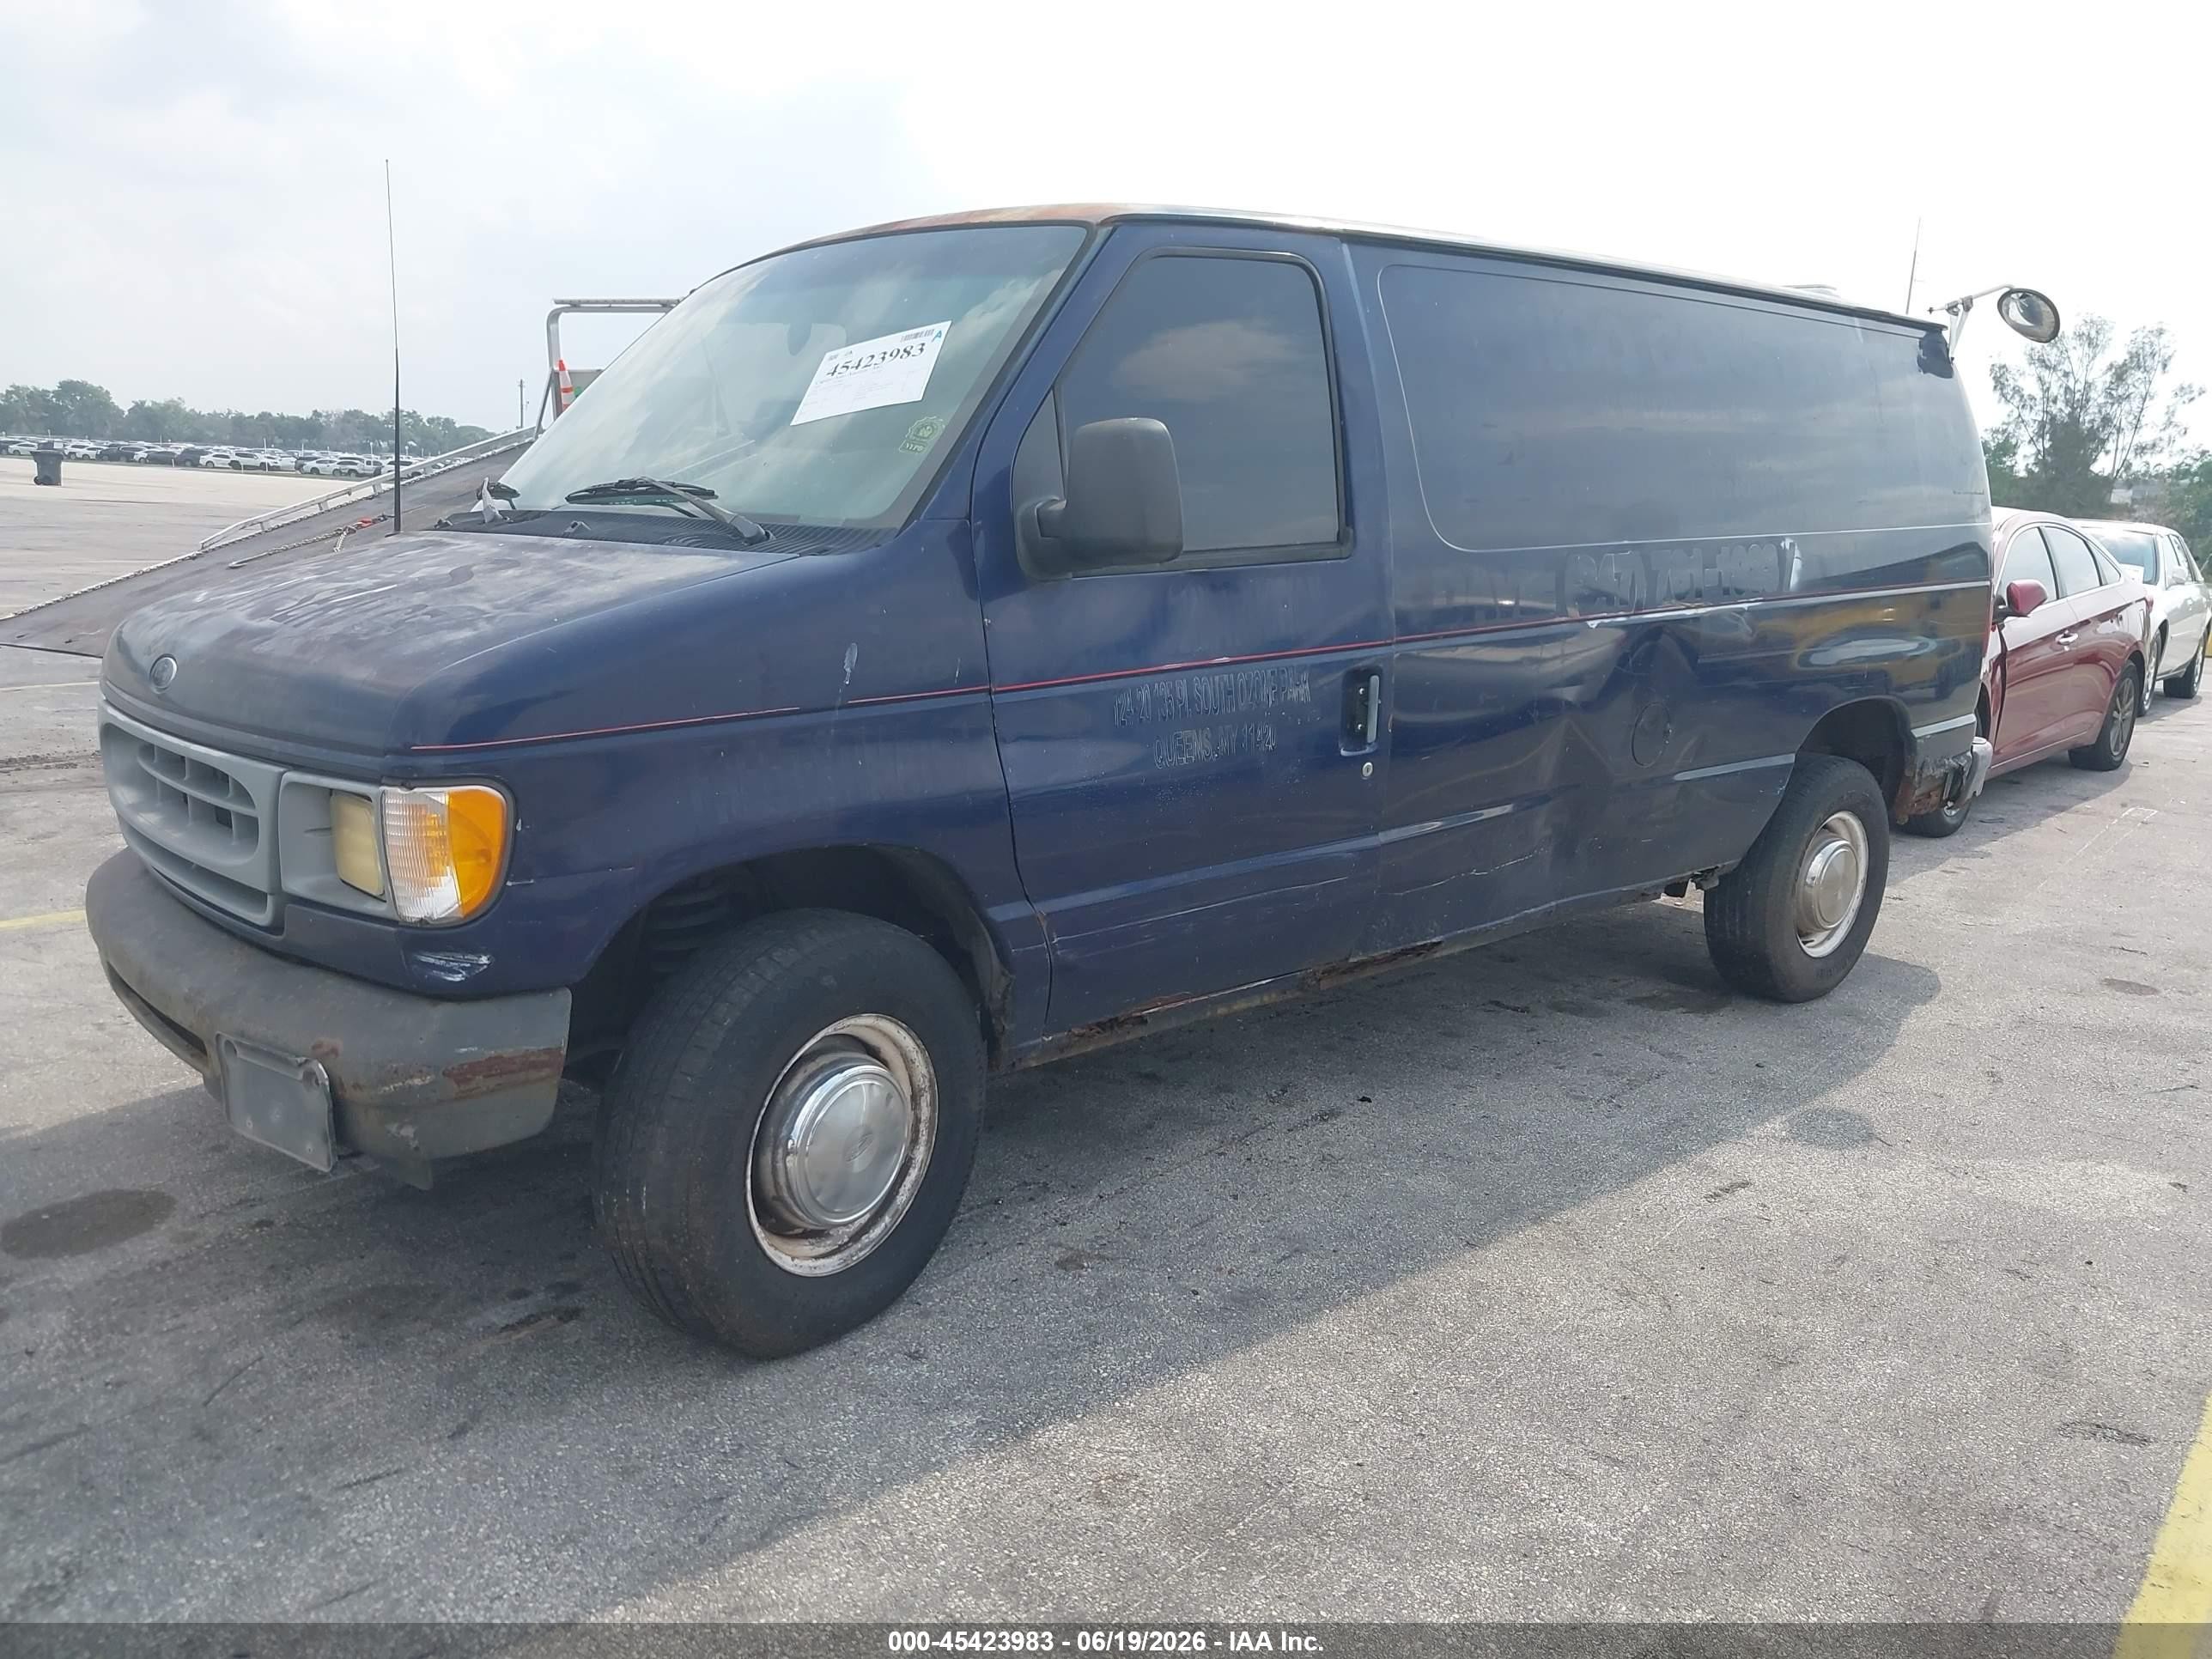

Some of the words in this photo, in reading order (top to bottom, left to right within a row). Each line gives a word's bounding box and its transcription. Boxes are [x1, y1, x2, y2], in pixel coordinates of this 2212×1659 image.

[826, 342, 926, 377] 45423983
[1194, 673, 1236, 716] SOUTH
[1237, 667, 1278, 708] OZONE
[1279, 663, 1311, 704] PARK
[1218, 722, 1238, 757] NY
